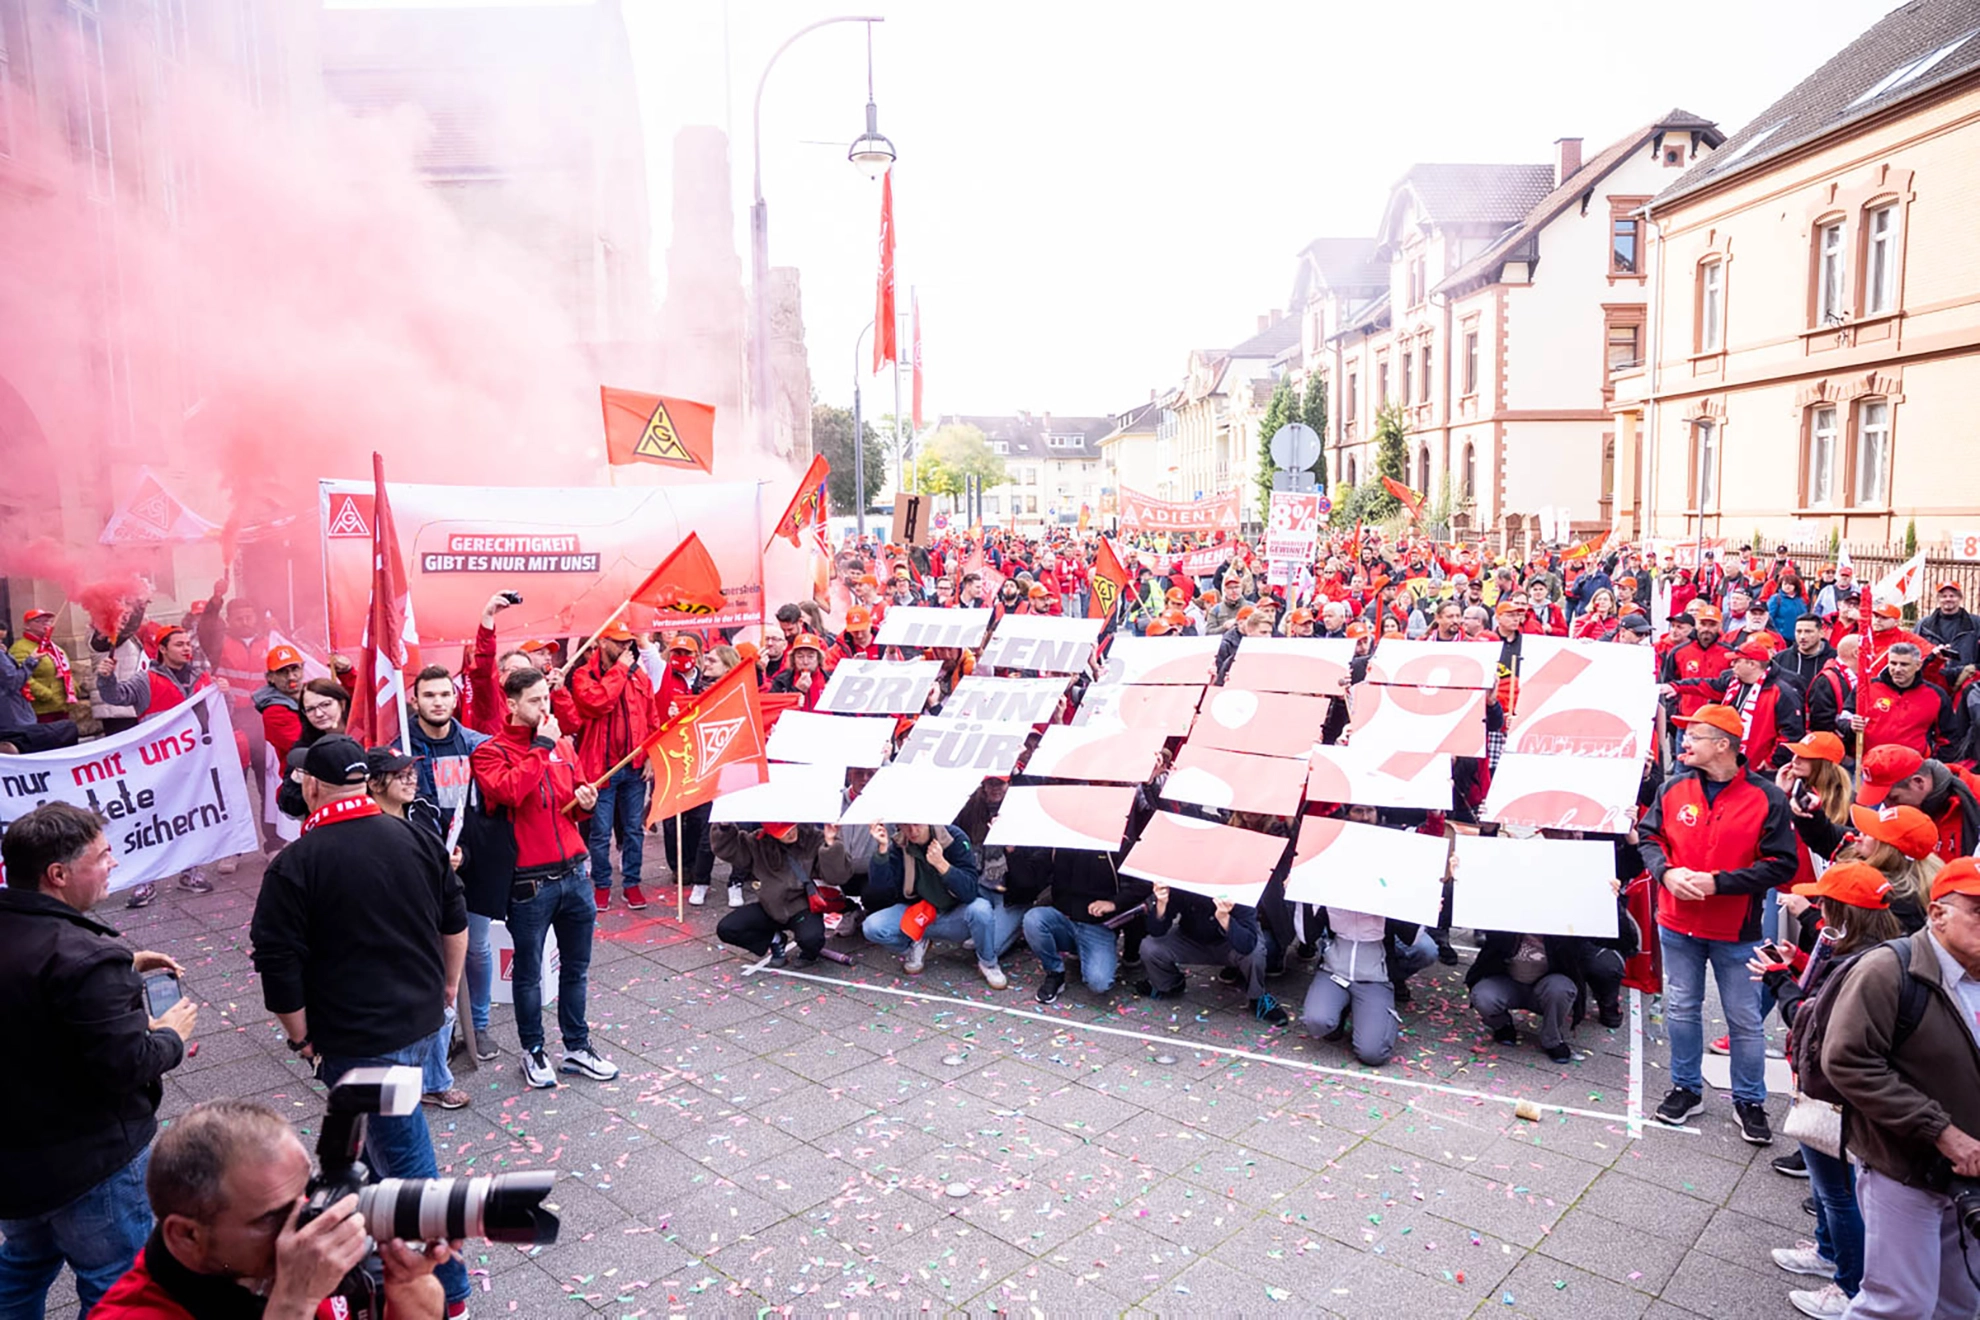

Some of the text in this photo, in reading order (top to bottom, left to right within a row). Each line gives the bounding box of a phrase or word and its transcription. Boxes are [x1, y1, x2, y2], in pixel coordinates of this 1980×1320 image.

[1140, 506, 1218, 524] ADIENT
[450, 536, 576, 552] GERECHTIGKEIT
[424, 555, 597, 571] GIBT ES NUR MIT UNS!
[2, 699, 213, 798] nur mit uns!
[896, 721, 1024, 771] FÜR
[123, 767, 229, 855] sichern!
